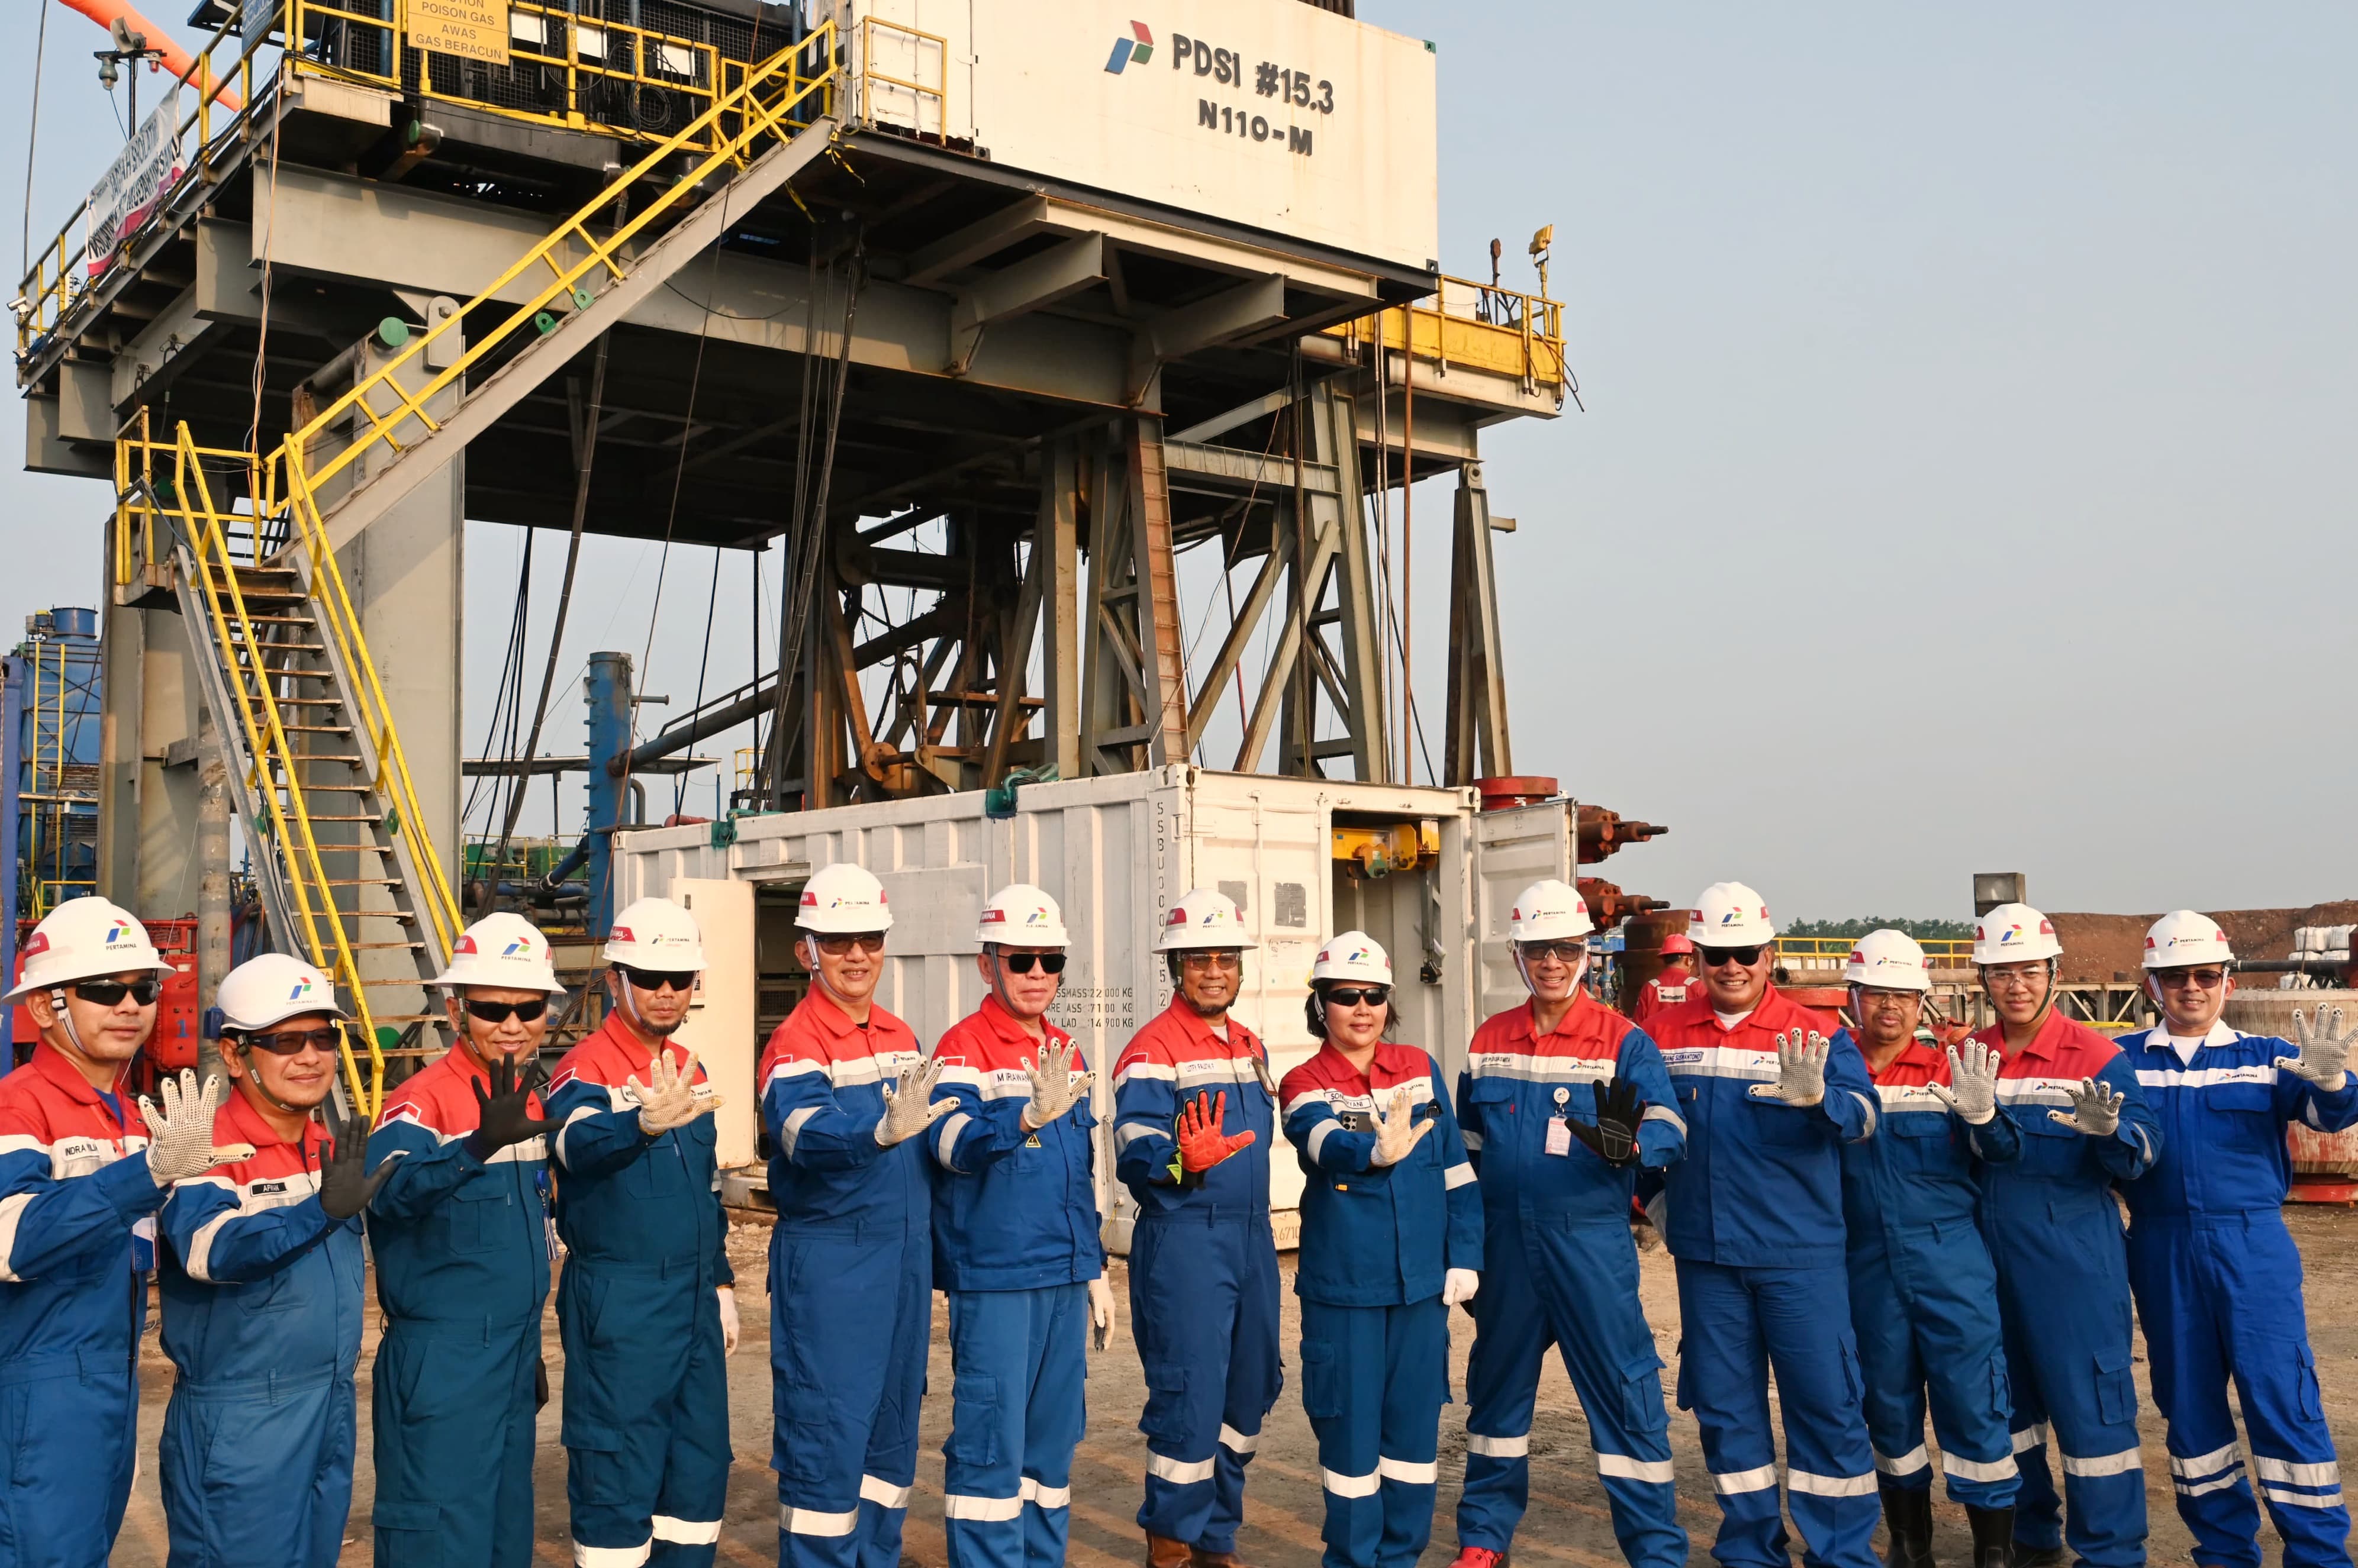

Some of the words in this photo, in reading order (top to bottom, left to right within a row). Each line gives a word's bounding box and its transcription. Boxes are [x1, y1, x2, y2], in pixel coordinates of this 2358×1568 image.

[422, 2, 466, 20] POISON
[470, 12, 495, 25] GAS
[442, 24, 476, 39] AWAS
[415, 33, 441, 47] GAS
[445, 39, 502, 59] BERACUN
[1172, 33, 1241, 88] PDSI
[1255, 62, 1334, 115] #15.3
[1197, 99, 1313, 156] N110-M
[1122, 988, 1133, 998] KG
[1122, 1003, 1133, 1013] KG
[176, 1019, 188, 1038] 1
[1122, 1018, 1133, 1028] KG
[997, 1073, 1004, 1083] M
[65, 1144, 86, 1156] INDRA
